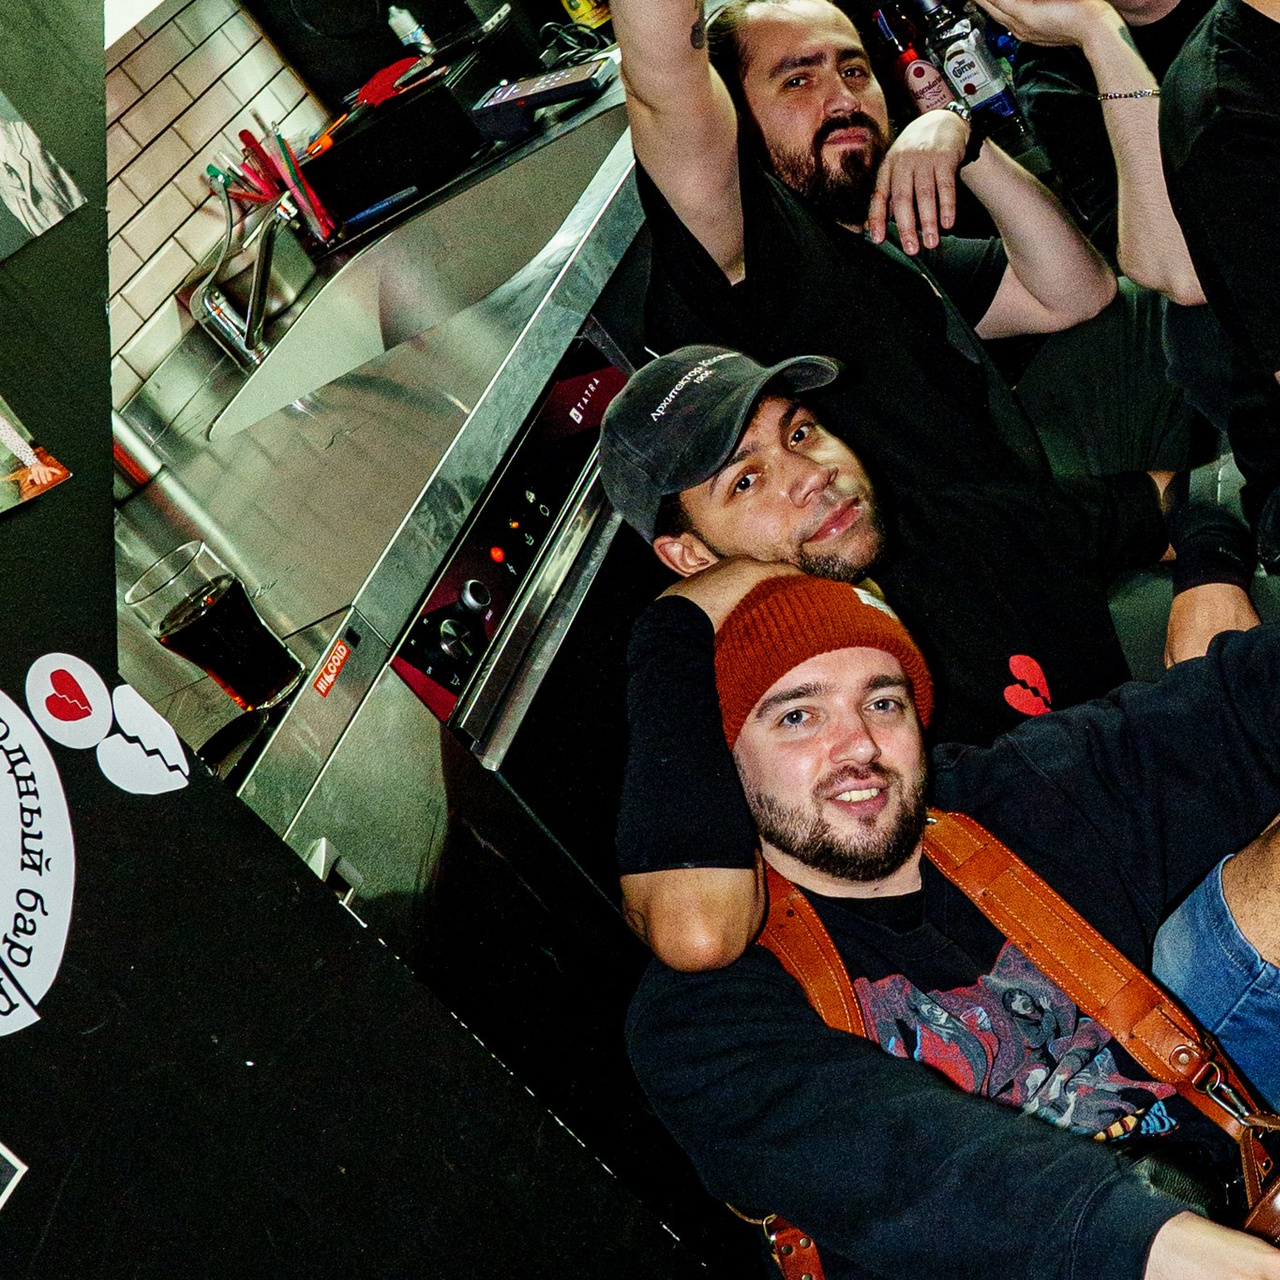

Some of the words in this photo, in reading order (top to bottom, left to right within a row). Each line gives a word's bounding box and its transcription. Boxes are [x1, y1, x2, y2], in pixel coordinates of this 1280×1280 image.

[951, 59, 976, 78] Cuervo
[576, 376, 600, 410] TATRA
[649, 365, 704, 421] Архитектор
[2, 887, 49, 969] бар
